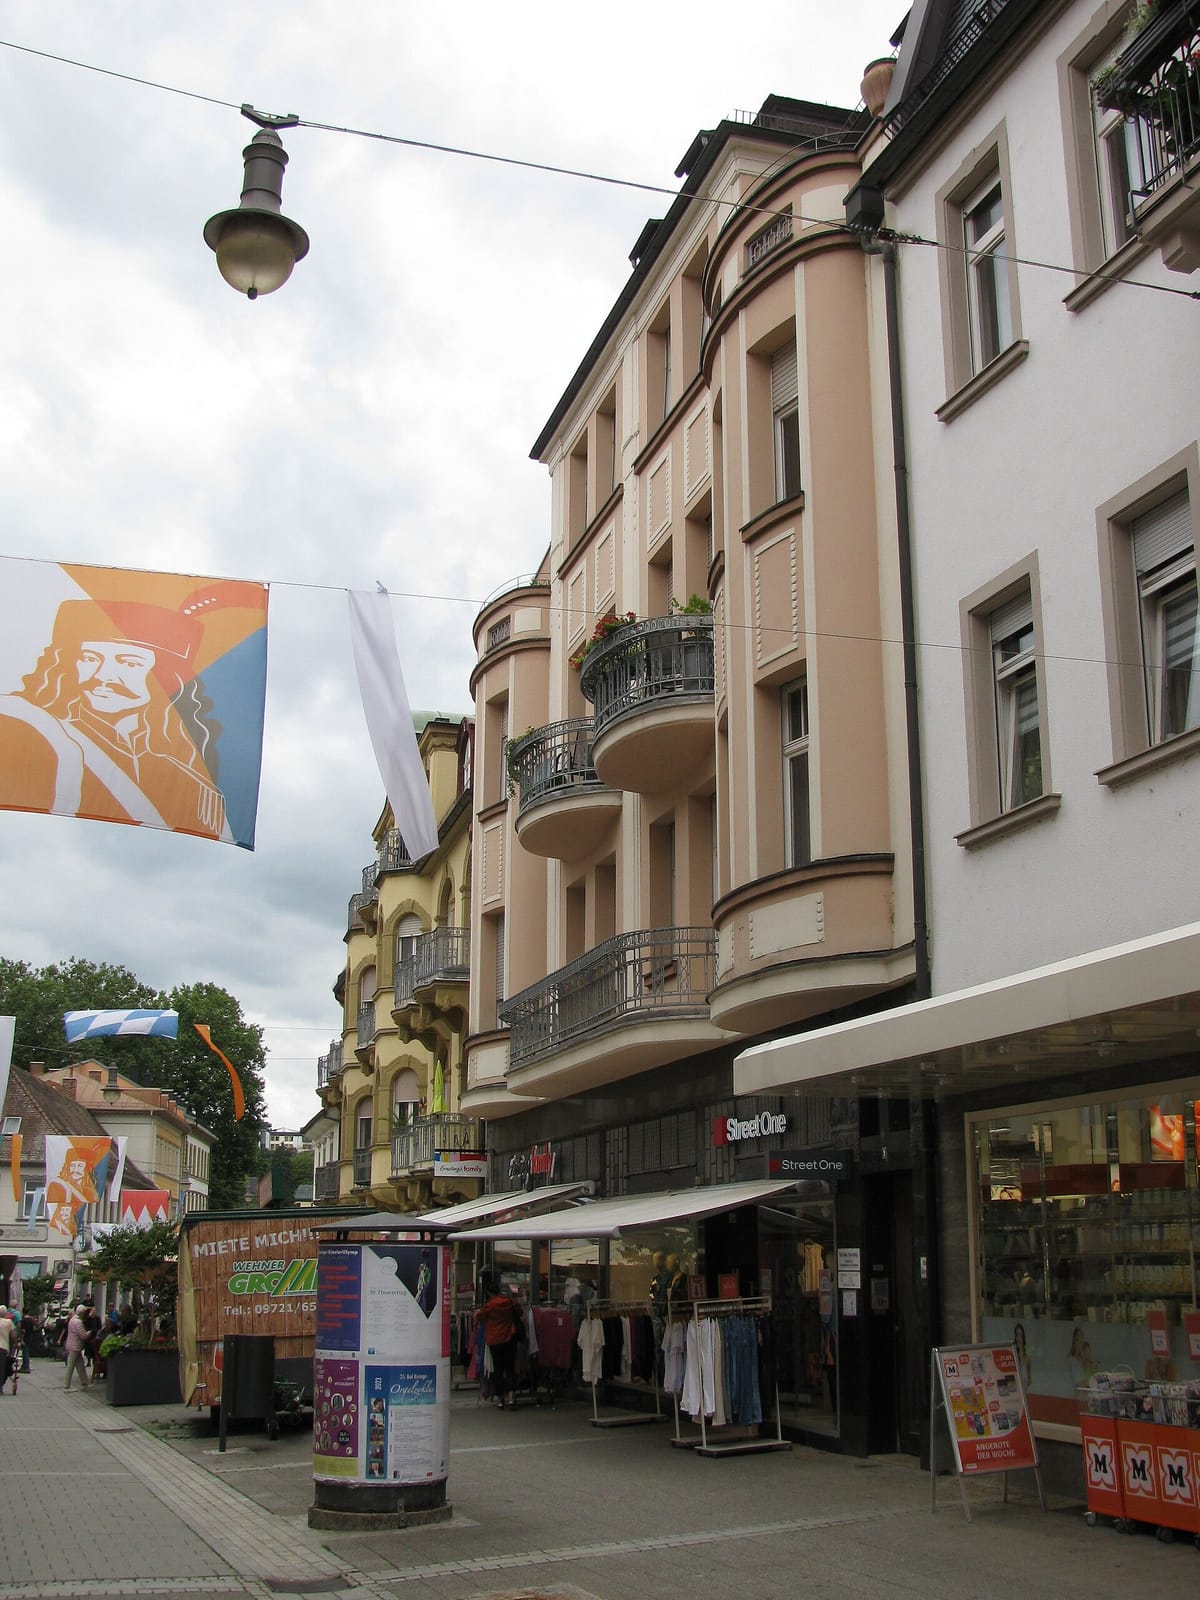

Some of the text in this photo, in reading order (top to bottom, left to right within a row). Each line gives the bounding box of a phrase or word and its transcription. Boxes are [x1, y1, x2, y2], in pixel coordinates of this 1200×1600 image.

[727, 1112, 787, 1141] Street One
[464, 1164, 483, 1174] family
[782, 1160, 844, 1170] Street One
[194, 1237, 250, 1258] MIETE
[233, 1260, 286, 1272] WEHNER
[224, 1301, 318, 1316] Tel.: 09721/65
[976, 1440, 1010, 1451] ANGEBOTE
[977, 1448, 1017, 1460] DER WOCHE
[1094, 1453, 1108, 1474] M
[1131, 1457, 1148, 1481] M
[1167, 1463, 1186, 1487] M
